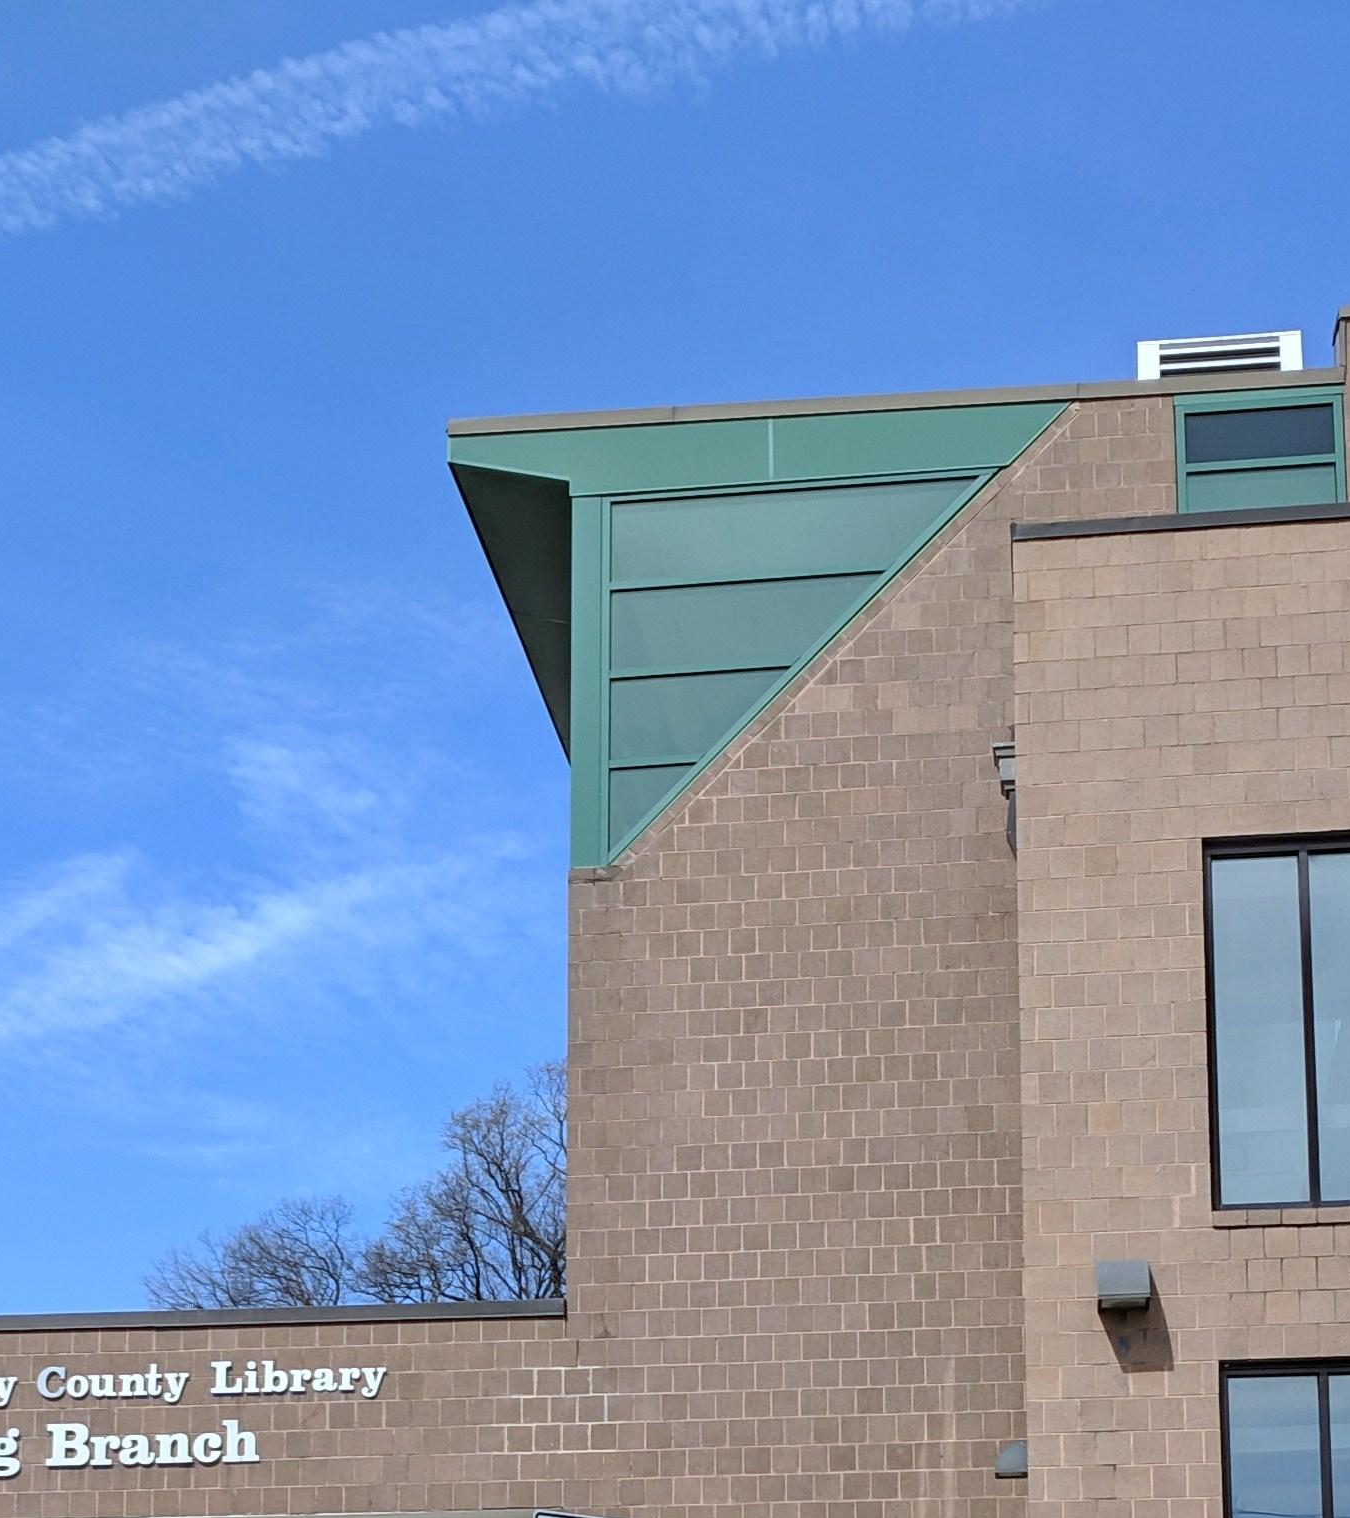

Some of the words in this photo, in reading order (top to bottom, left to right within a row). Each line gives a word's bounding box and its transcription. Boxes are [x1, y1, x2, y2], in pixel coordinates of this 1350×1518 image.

[36, 1363, 190, 1403] County
[209, 1359, 388, 1398] Library
[44, 1418, 260, 1469] Branch
